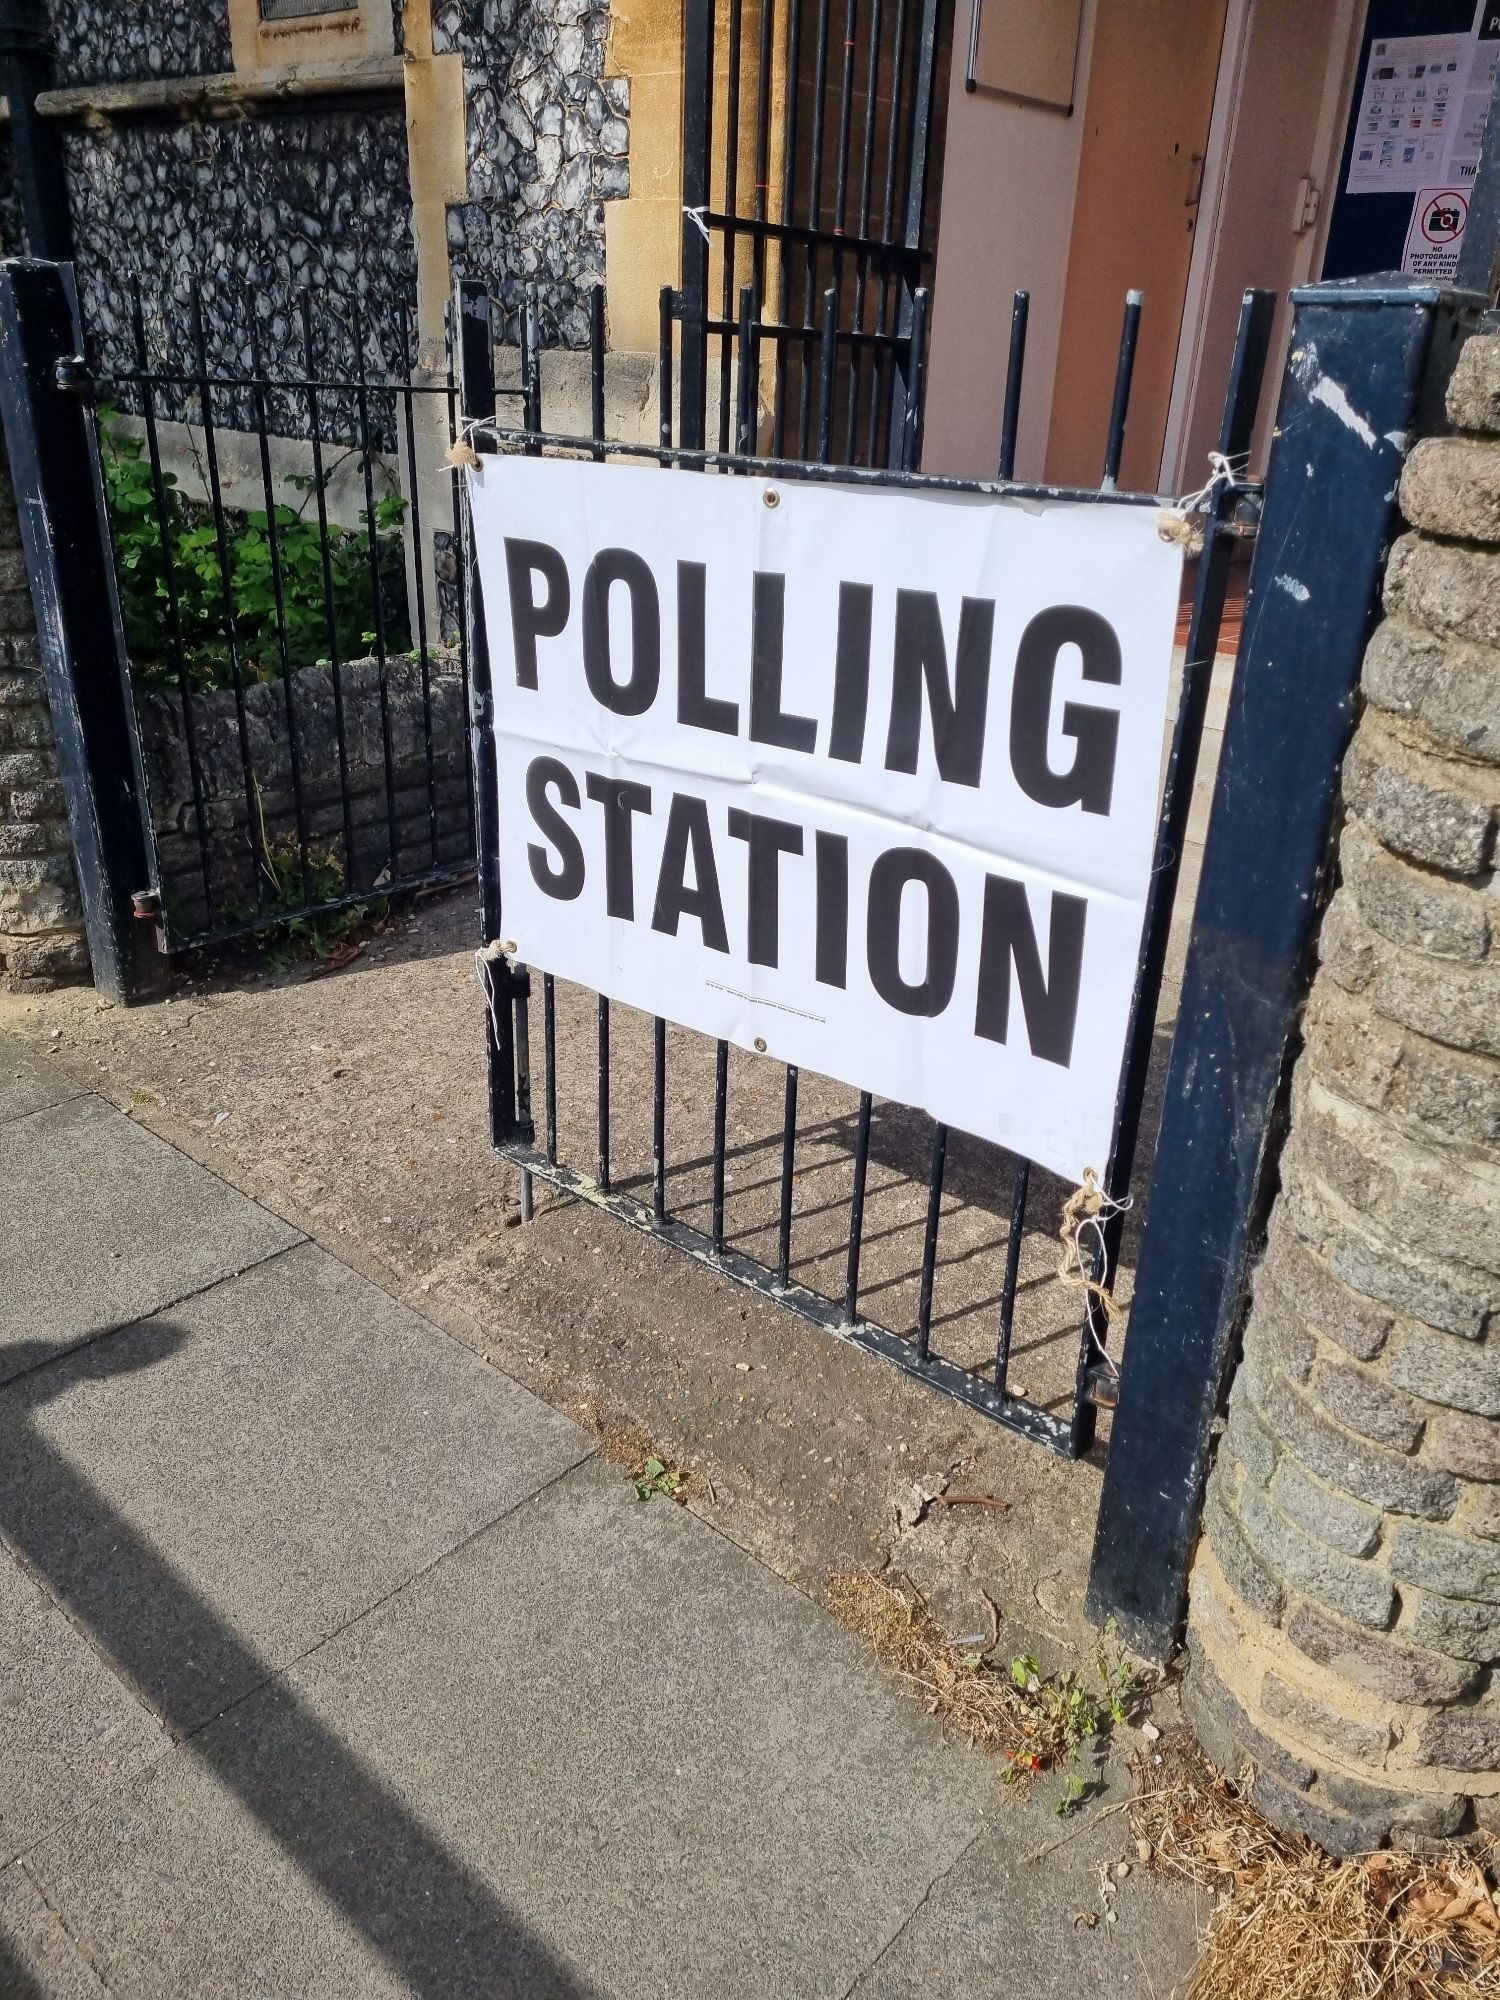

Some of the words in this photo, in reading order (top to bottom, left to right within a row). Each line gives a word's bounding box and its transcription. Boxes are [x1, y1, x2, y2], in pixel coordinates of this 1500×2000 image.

[1489, 17, 1500, 31] P
[1460, 166, 1477, 176] THA
[503, 536, 1123, 818] POLLING
[525, 754, 1088, 1070] STATION
